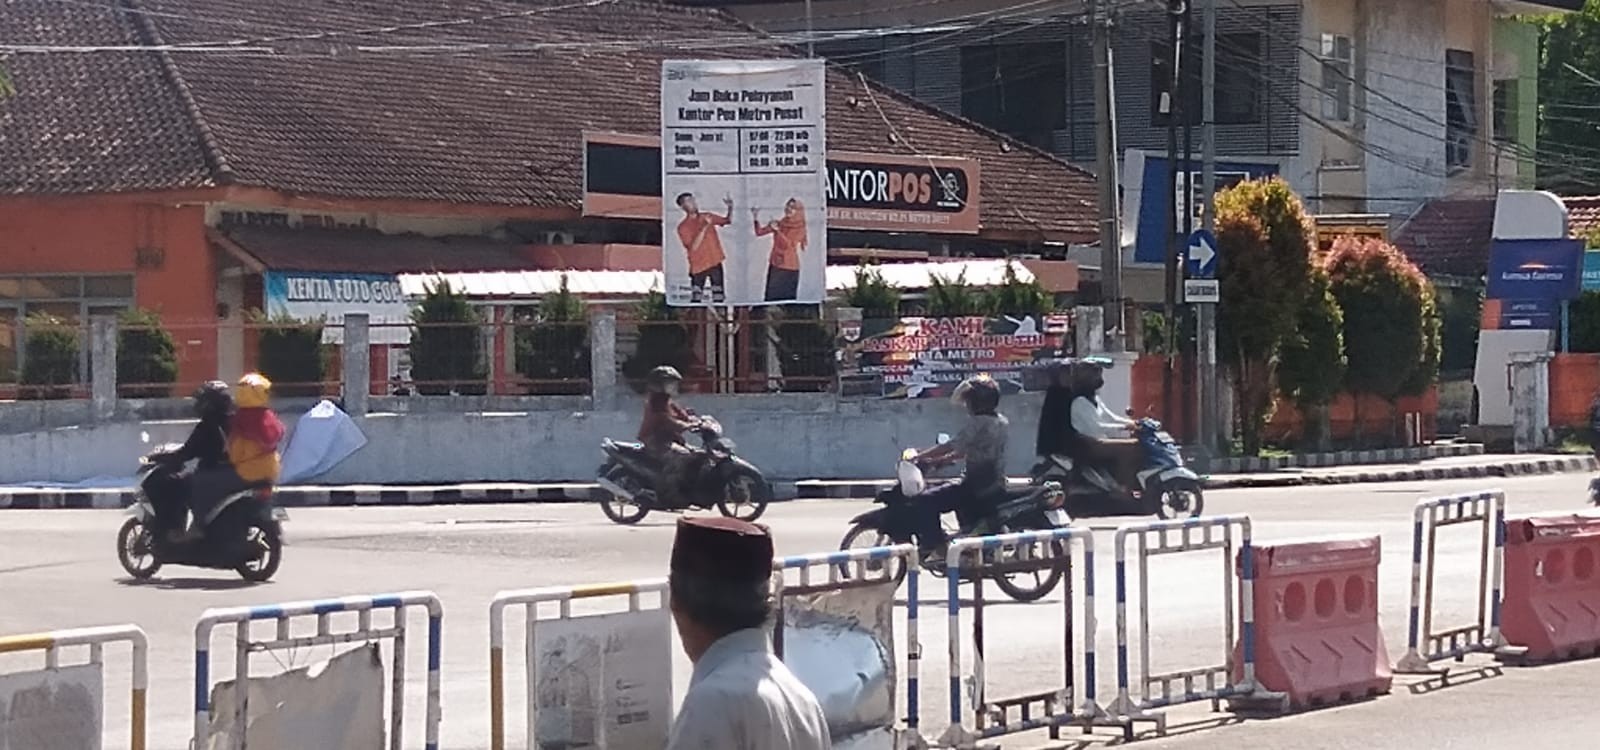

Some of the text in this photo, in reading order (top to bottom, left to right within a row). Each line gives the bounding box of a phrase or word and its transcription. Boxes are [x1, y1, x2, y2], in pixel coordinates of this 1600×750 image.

[688, 88, 793, 105] Jam Buka Pelayanan
[678, 106, 803, 121] Kantor Pos Metro Pusat
[287, 278, 402, 304] KENTA FOTO COP
[919, 316, 985, 336] KAMI
[909, 349, 996, 361] KOTA METRO
